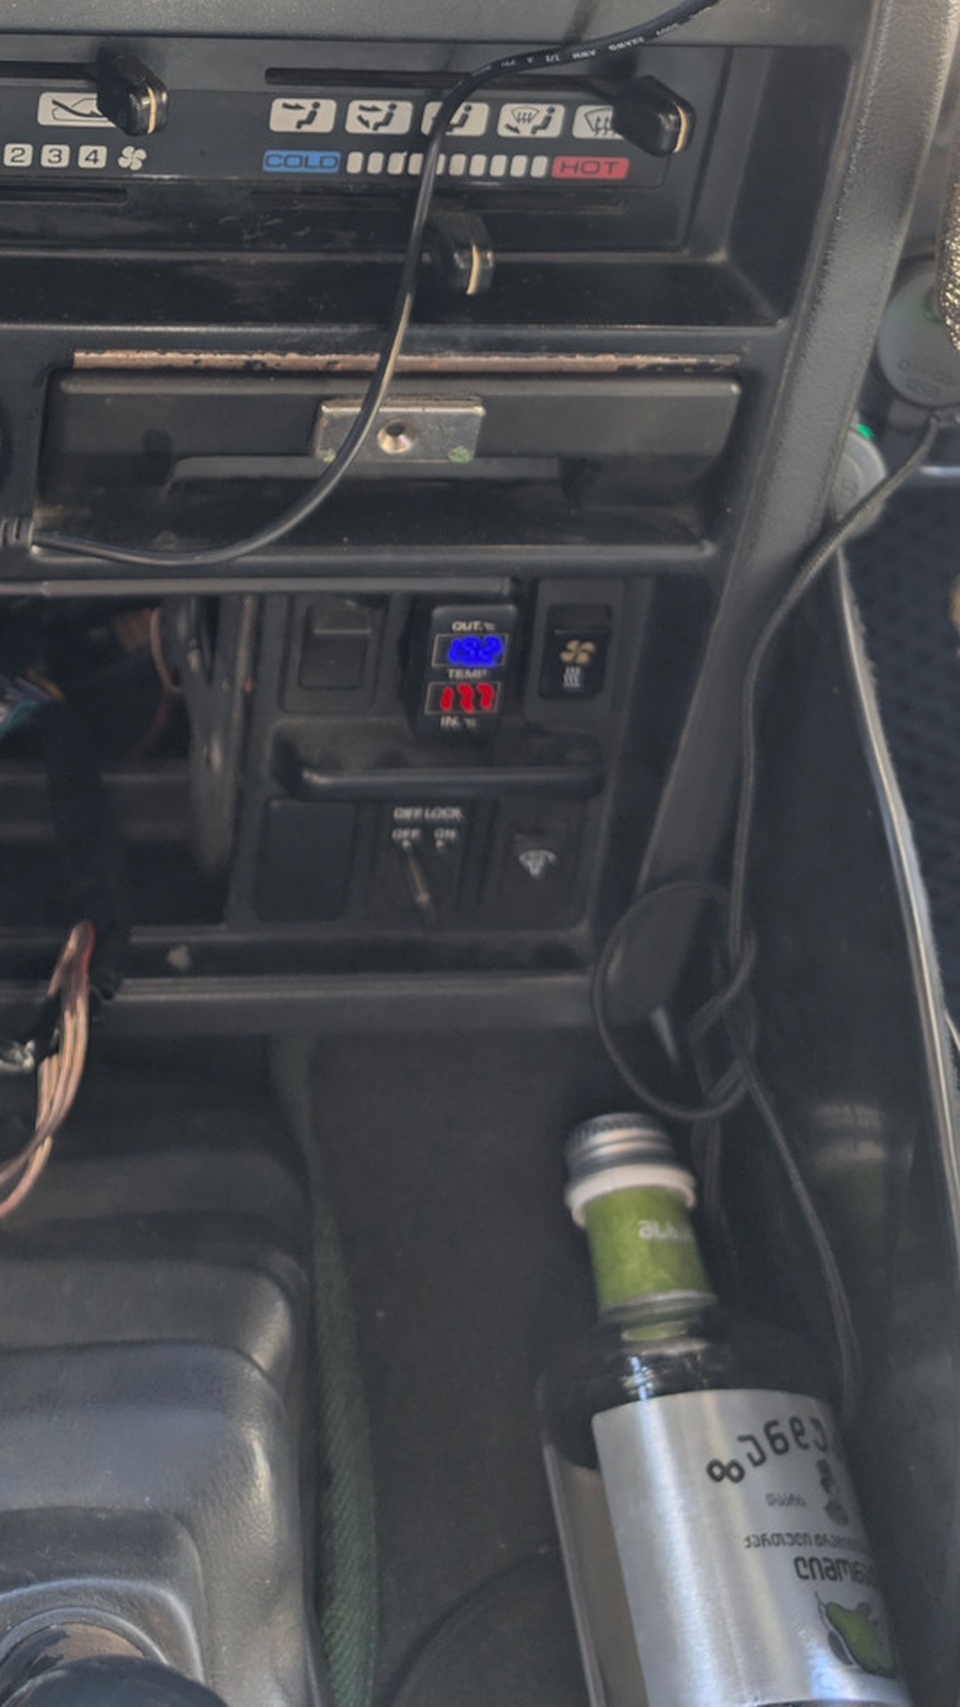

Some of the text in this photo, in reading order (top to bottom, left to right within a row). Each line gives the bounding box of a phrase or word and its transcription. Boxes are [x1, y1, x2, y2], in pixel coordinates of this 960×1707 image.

[10, 148, 26, 163] 2
[47, 149, 62, 164] 3
[84, 150, 100, 164] 4
[265, 153, 339, 169] COLD
[558, 160, 620, 175] HOT
[448, 669, 487, 679] TEMP
